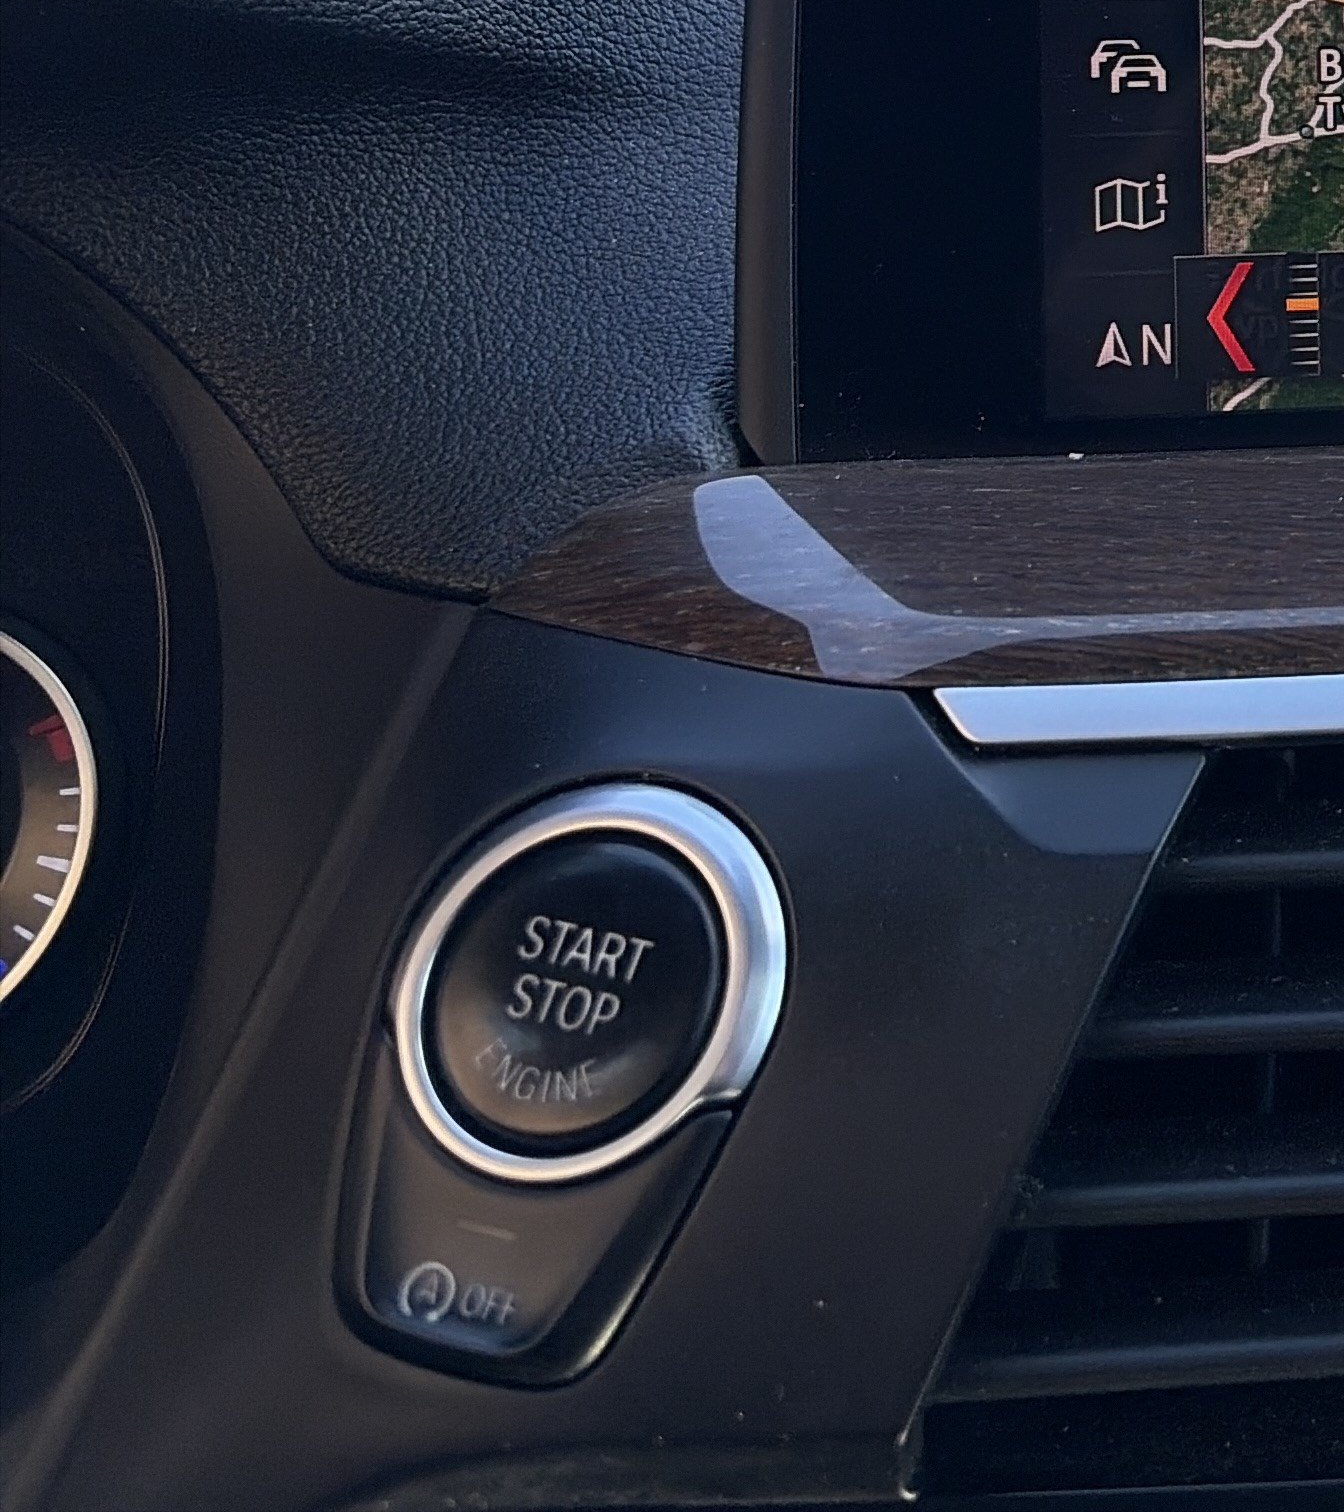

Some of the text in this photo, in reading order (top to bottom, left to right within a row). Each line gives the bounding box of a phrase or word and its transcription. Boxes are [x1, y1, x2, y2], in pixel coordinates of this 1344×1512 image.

[518, 916, 654, 983] START
[506, 973, 620, 1035] STOP
[474, 1039, 599, 1103] ENGINE
